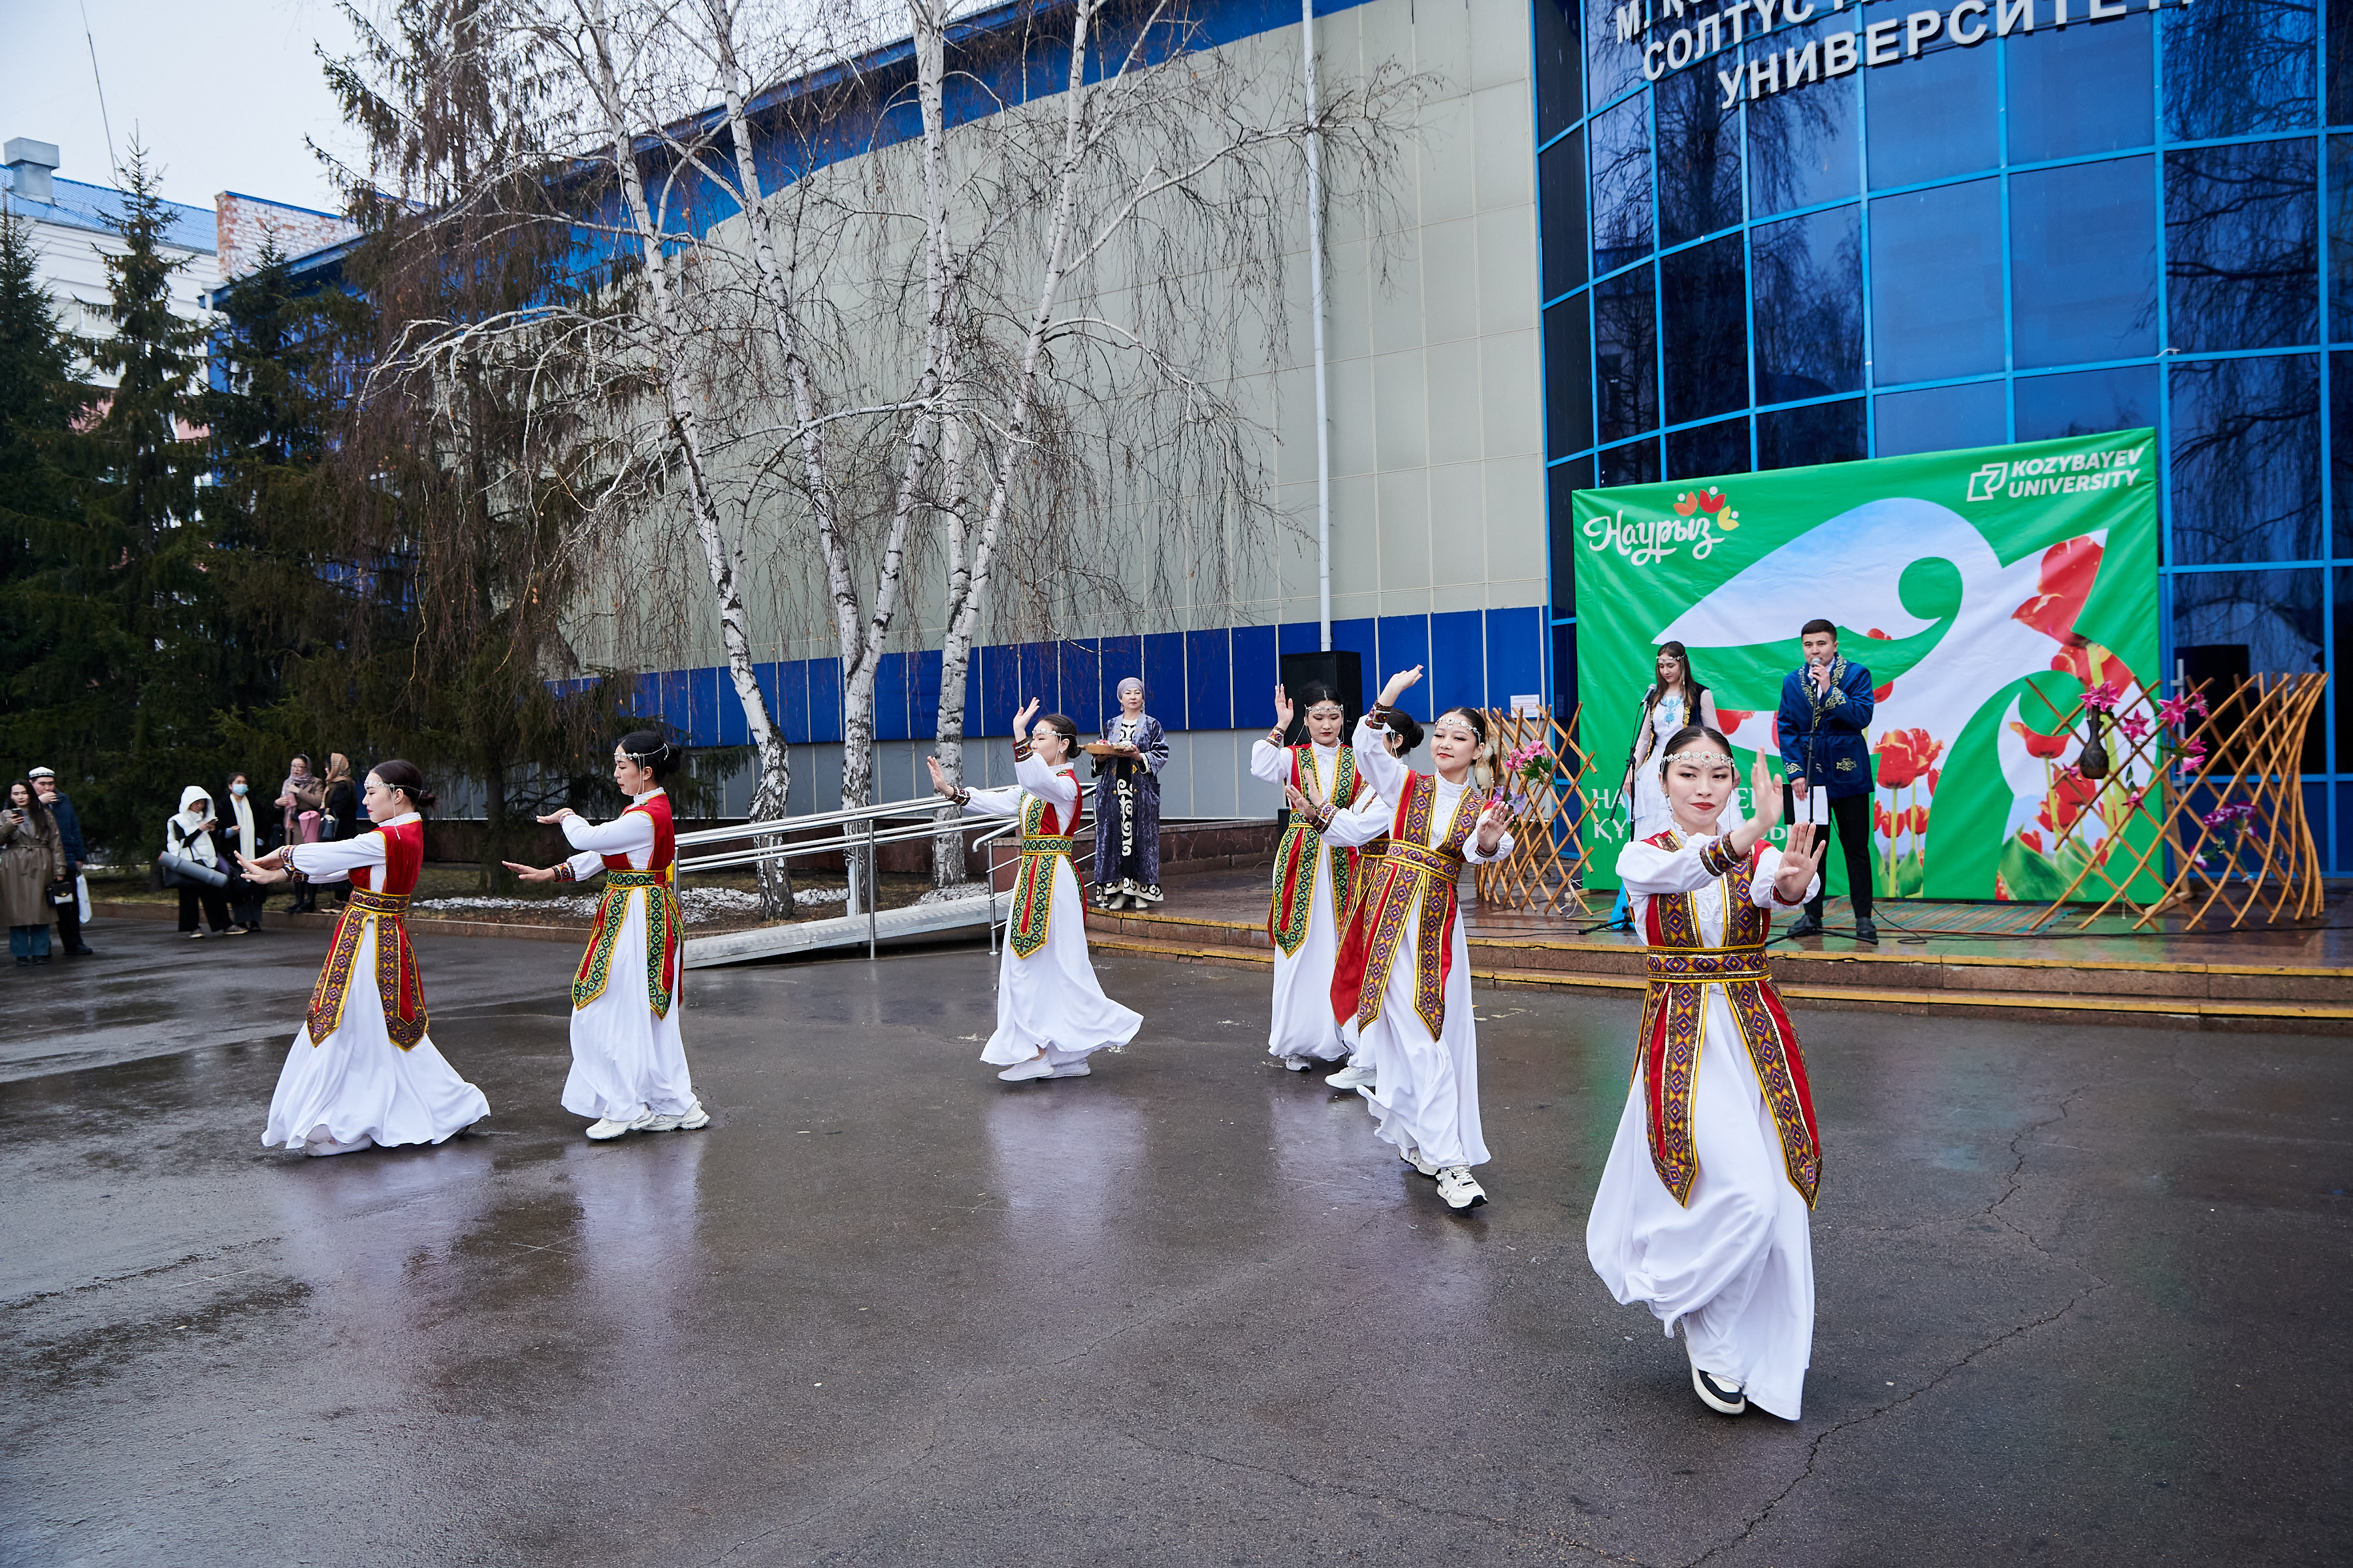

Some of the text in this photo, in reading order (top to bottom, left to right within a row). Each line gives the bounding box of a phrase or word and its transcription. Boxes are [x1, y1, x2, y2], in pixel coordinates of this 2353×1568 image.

[1717, 0, 2193, 110] УНИВЕРСИ
[2007, 468, 2141, 498] UNIVERSITY
[2011, 447, 2145, 477] KOZYBAYEV
[1583, 509, 1725, 566] Наурыз
